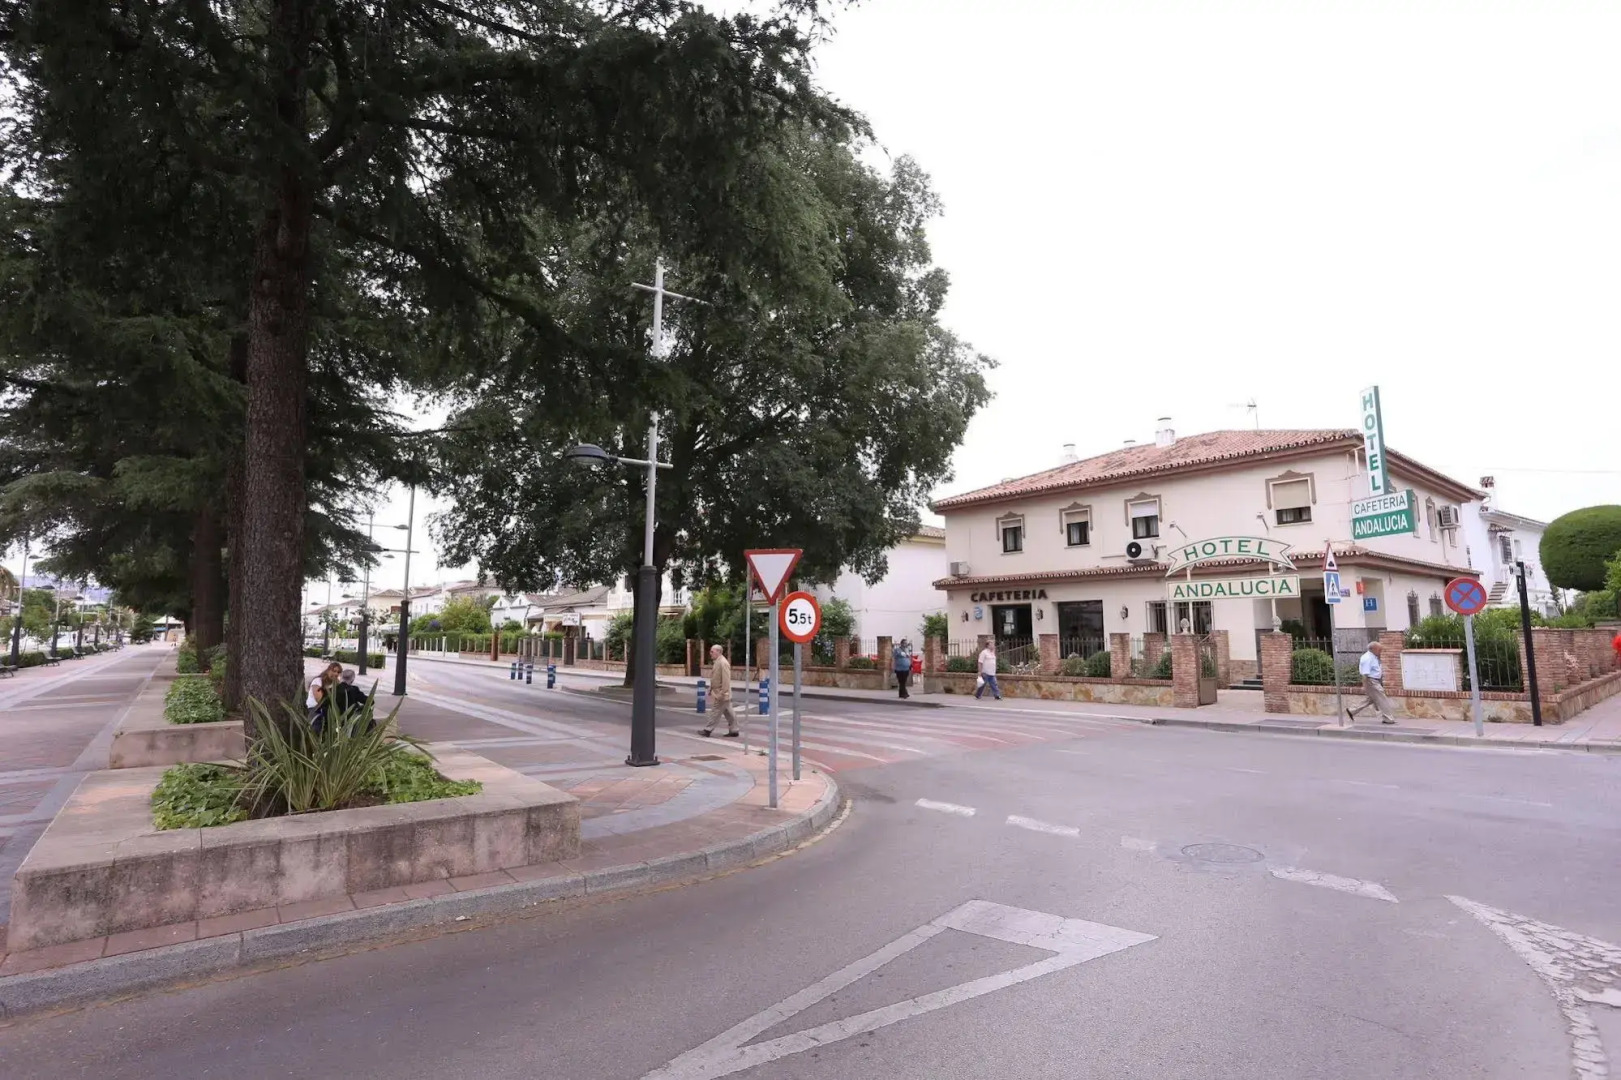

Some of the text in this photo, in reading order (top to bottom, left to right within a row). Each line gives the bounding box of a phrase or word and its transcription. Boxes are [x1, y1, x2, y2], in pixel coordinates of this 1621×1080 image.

[1362, 392, 1381, 491] HOTEL
[1354, 494, 1406, 515] CAFETERIA
[1355, 513, 1408, 536] ANDALUCIA
[1183, 539, 1270, 561] HOTEL
[970, 589, 1048, 603] CAFETERIA
[1173, 579, 1293, 598] ANDALUCIA
